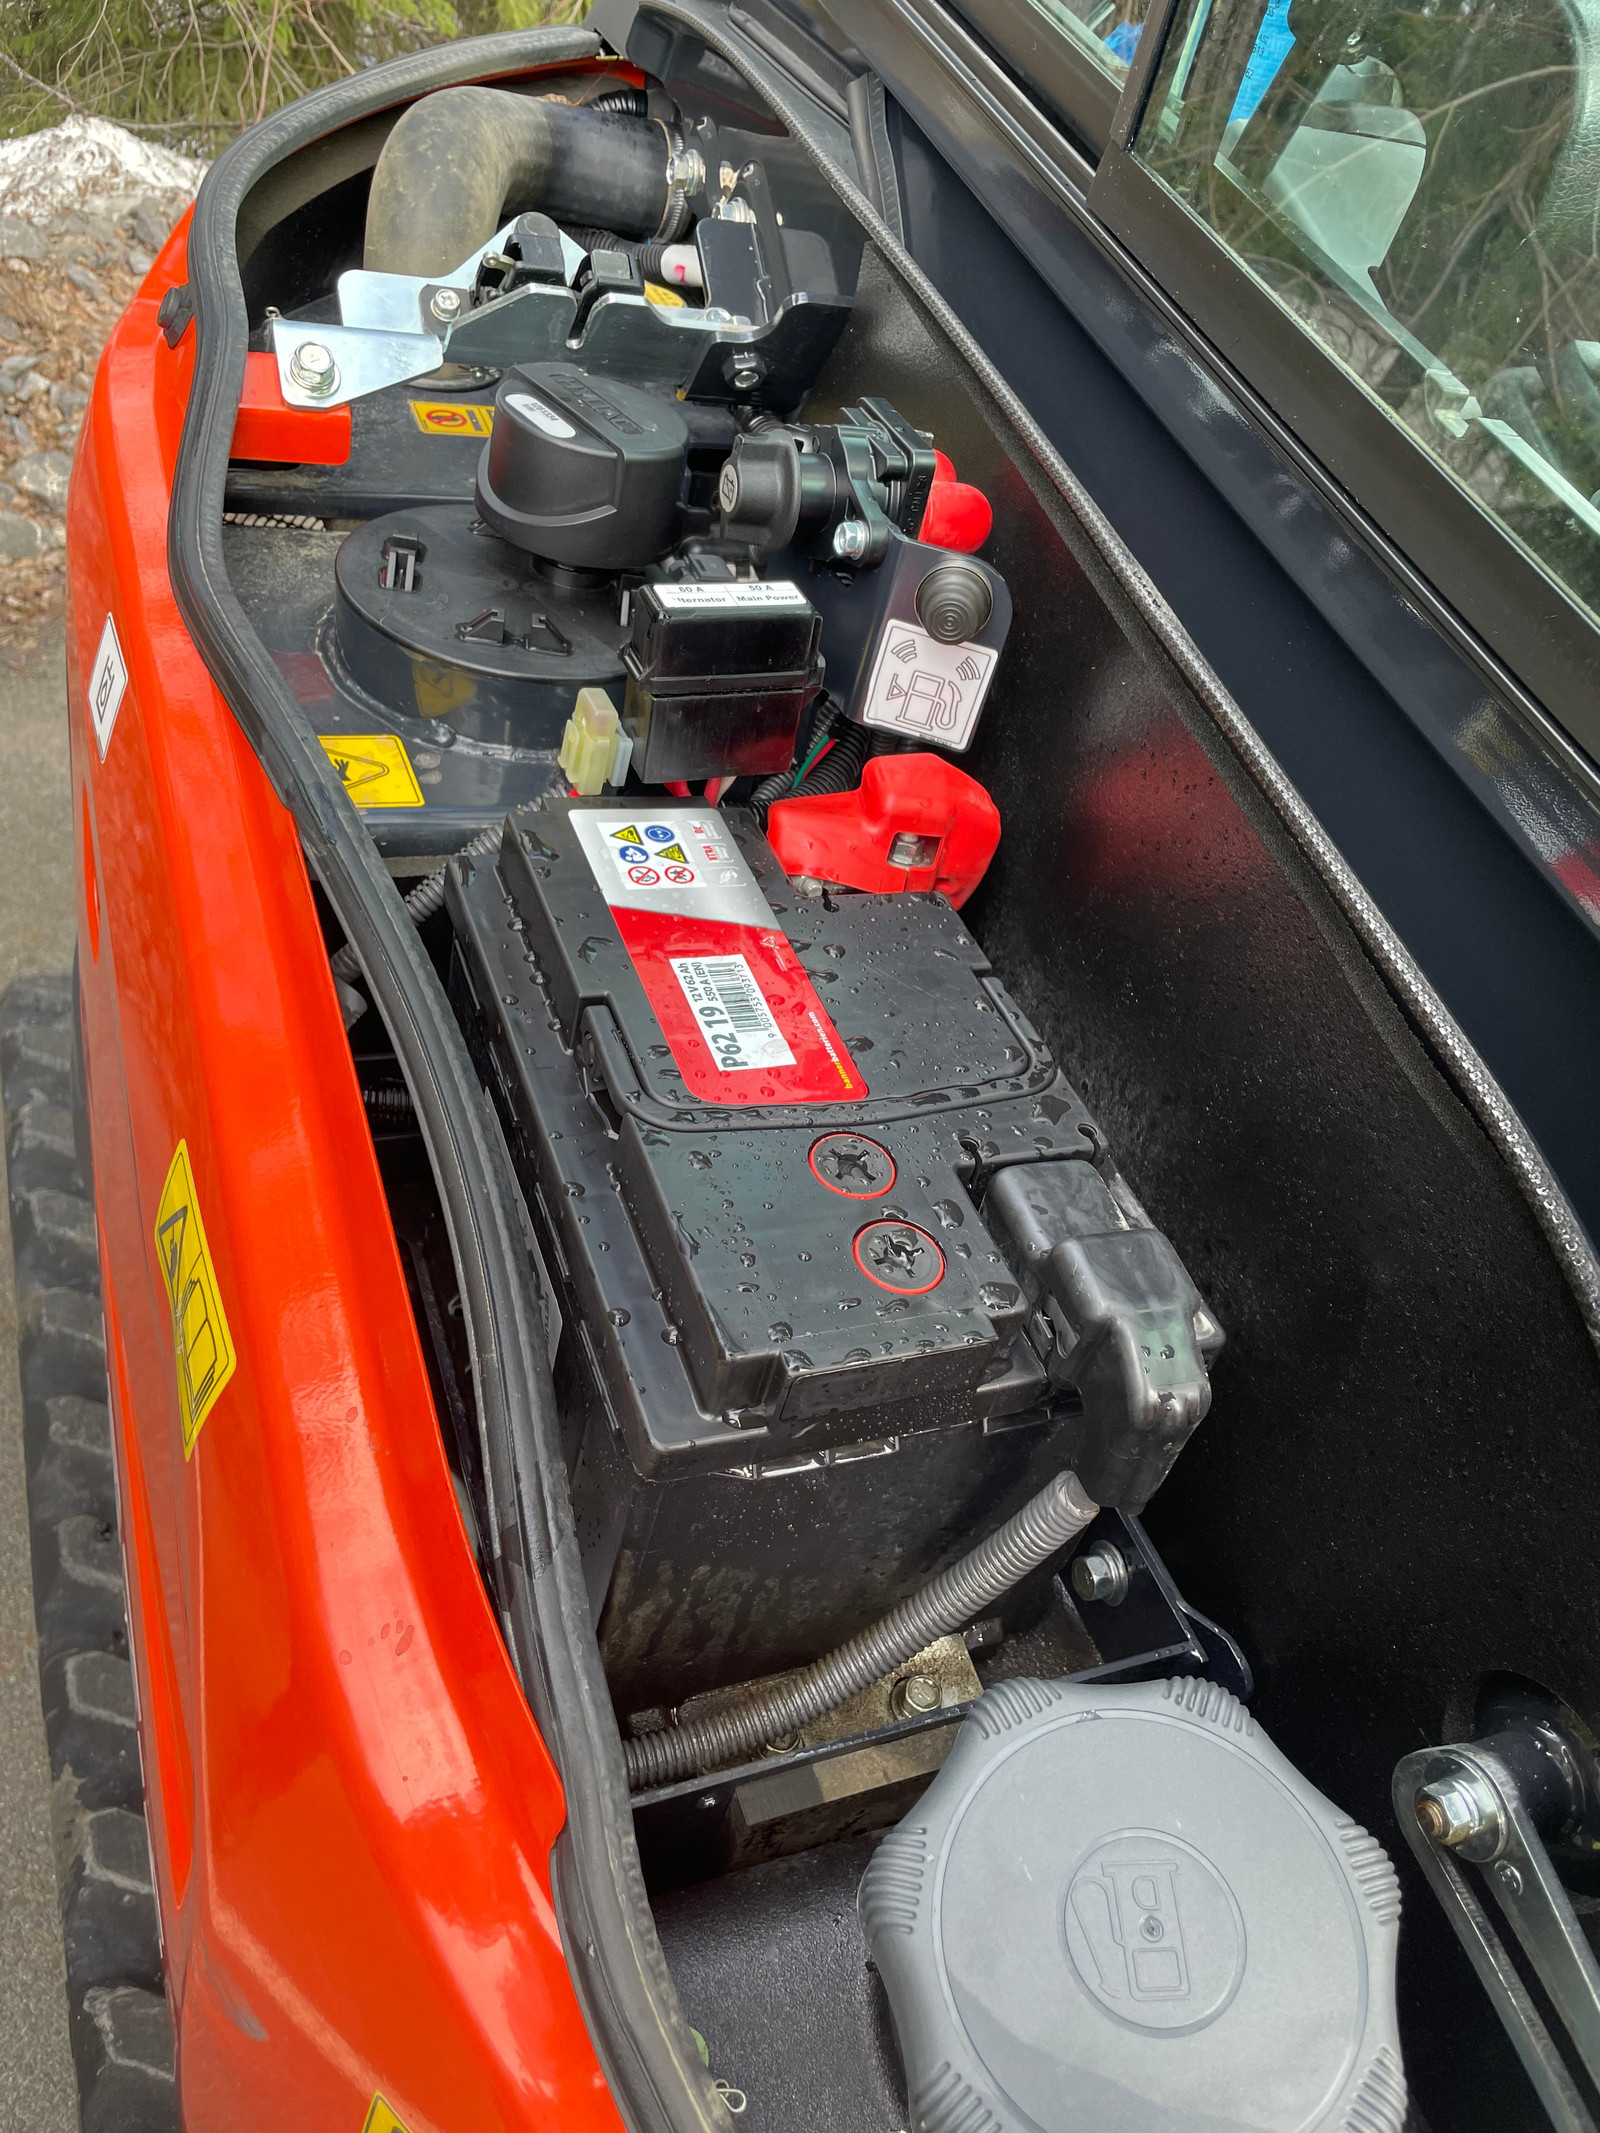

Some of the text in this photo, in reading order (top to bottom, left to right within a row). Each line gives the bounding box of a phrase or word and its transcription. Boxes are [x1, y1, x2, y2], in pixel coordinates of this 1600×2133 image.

[736, 594, 799, 603] Main Power
[698, 1006, 749, 1068] P62 19
[808, 1011, 853, 1090] bannerbatterien.com
